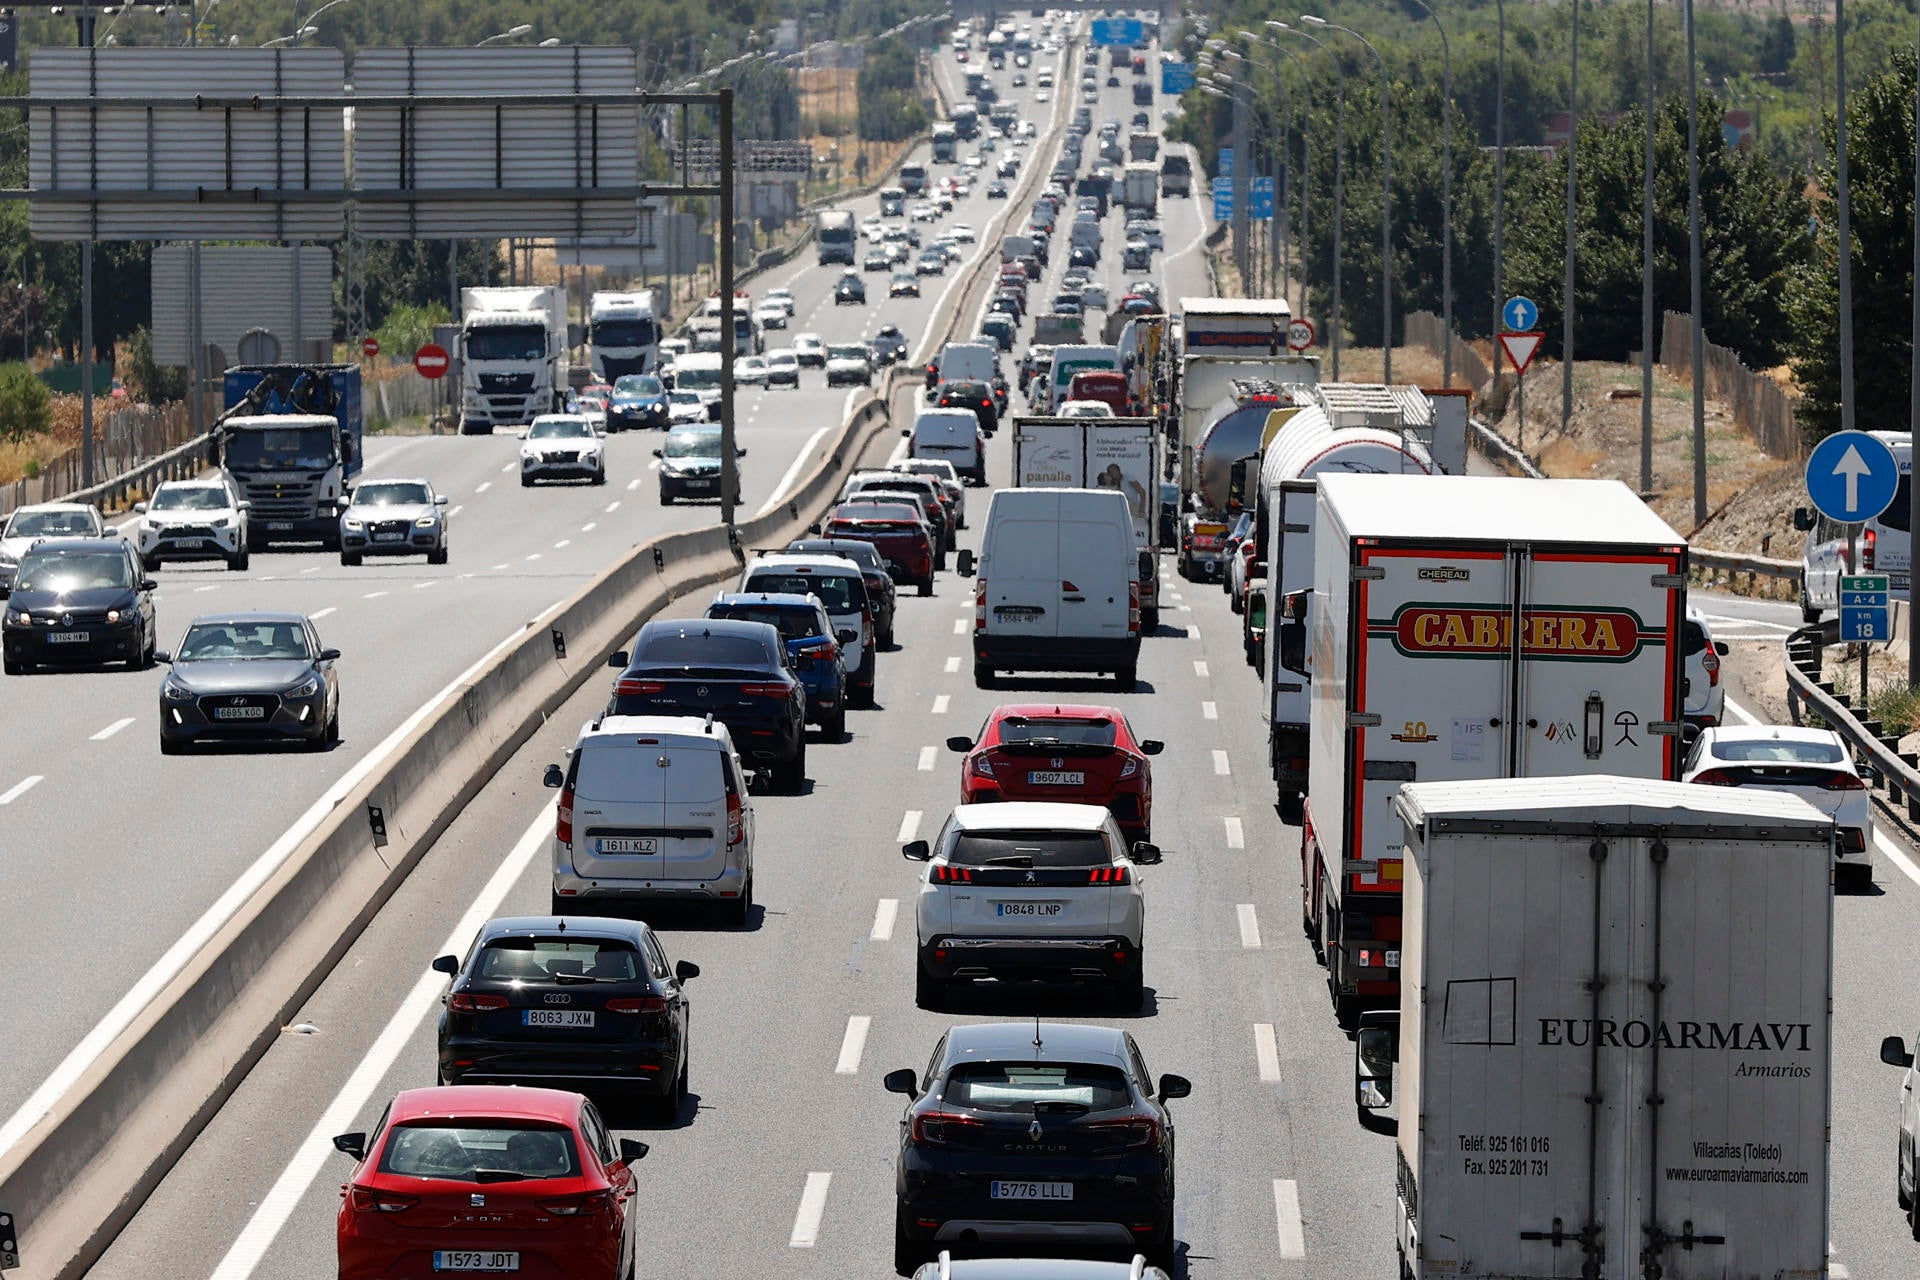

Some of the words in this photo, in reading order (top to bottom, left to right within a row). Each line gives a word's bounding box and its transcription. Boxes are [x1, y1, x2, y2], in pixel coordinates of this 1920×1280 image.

[1419, 569, 1469, 580] CHEREAU
[1853, 580, 1875, 589] E-5
[1853, 595, 1875, 604] A-4
[1857, 612, 1872, 620] km
[1414, 614, 1621, 651] CABRERA
[1856, 624, 1874, 638] 18
[1404, 721, 1427, 737] 50
[1465, 724, 1484, 734] IFS
[1035, 773, 1060, 782] 9607
[1063, 774, 1082, 783] LCL
[606, 840, 628, 850] 1611
[634, 840, 652, 850] KLZ
[1004, 904, 1034, 915] 0848
[1038, 905, 1061, 916] LNP
[530, 1012, 562, 1024] 8063
[568, 1012, 592, 1025] JXM
[1538, 1018, 1812, 1052] EUROARMAVI
[1734, 1062, 1811, 1078] Armarios
[1004, 1144, 1067, 1152] CAPTUR
[1458, 1134, 1486, 1151] Teléf.
[1489, 1136, 1508, 1152] 925
[1510, 1136, 1528, 1152] 161
[1530, 1136, 1550, 1152] 016
[1692, 1140, 1742, 1161] Villacañas
[1743, 1142, 1782, 1162] (Toledo)
[1464, 1158, 1486, 1174] Fax.
[1488, 1159, 1507, 1175] 925
[1509, 1160, 1528, 1176] 201
[1531, 1160, 1548, 1176] 731
[1666, 1166, 1808, 1184] www.euroarmaviarmarios.com
[1000, 1184, 1038, 1197] 5776
[1042, 1184, 1070, 1198] LLL
[6, 1254, 14, 1266] 9
[448, 1253, 482, 1267] 1573
[486, 1254, 514, 1268] JDT
